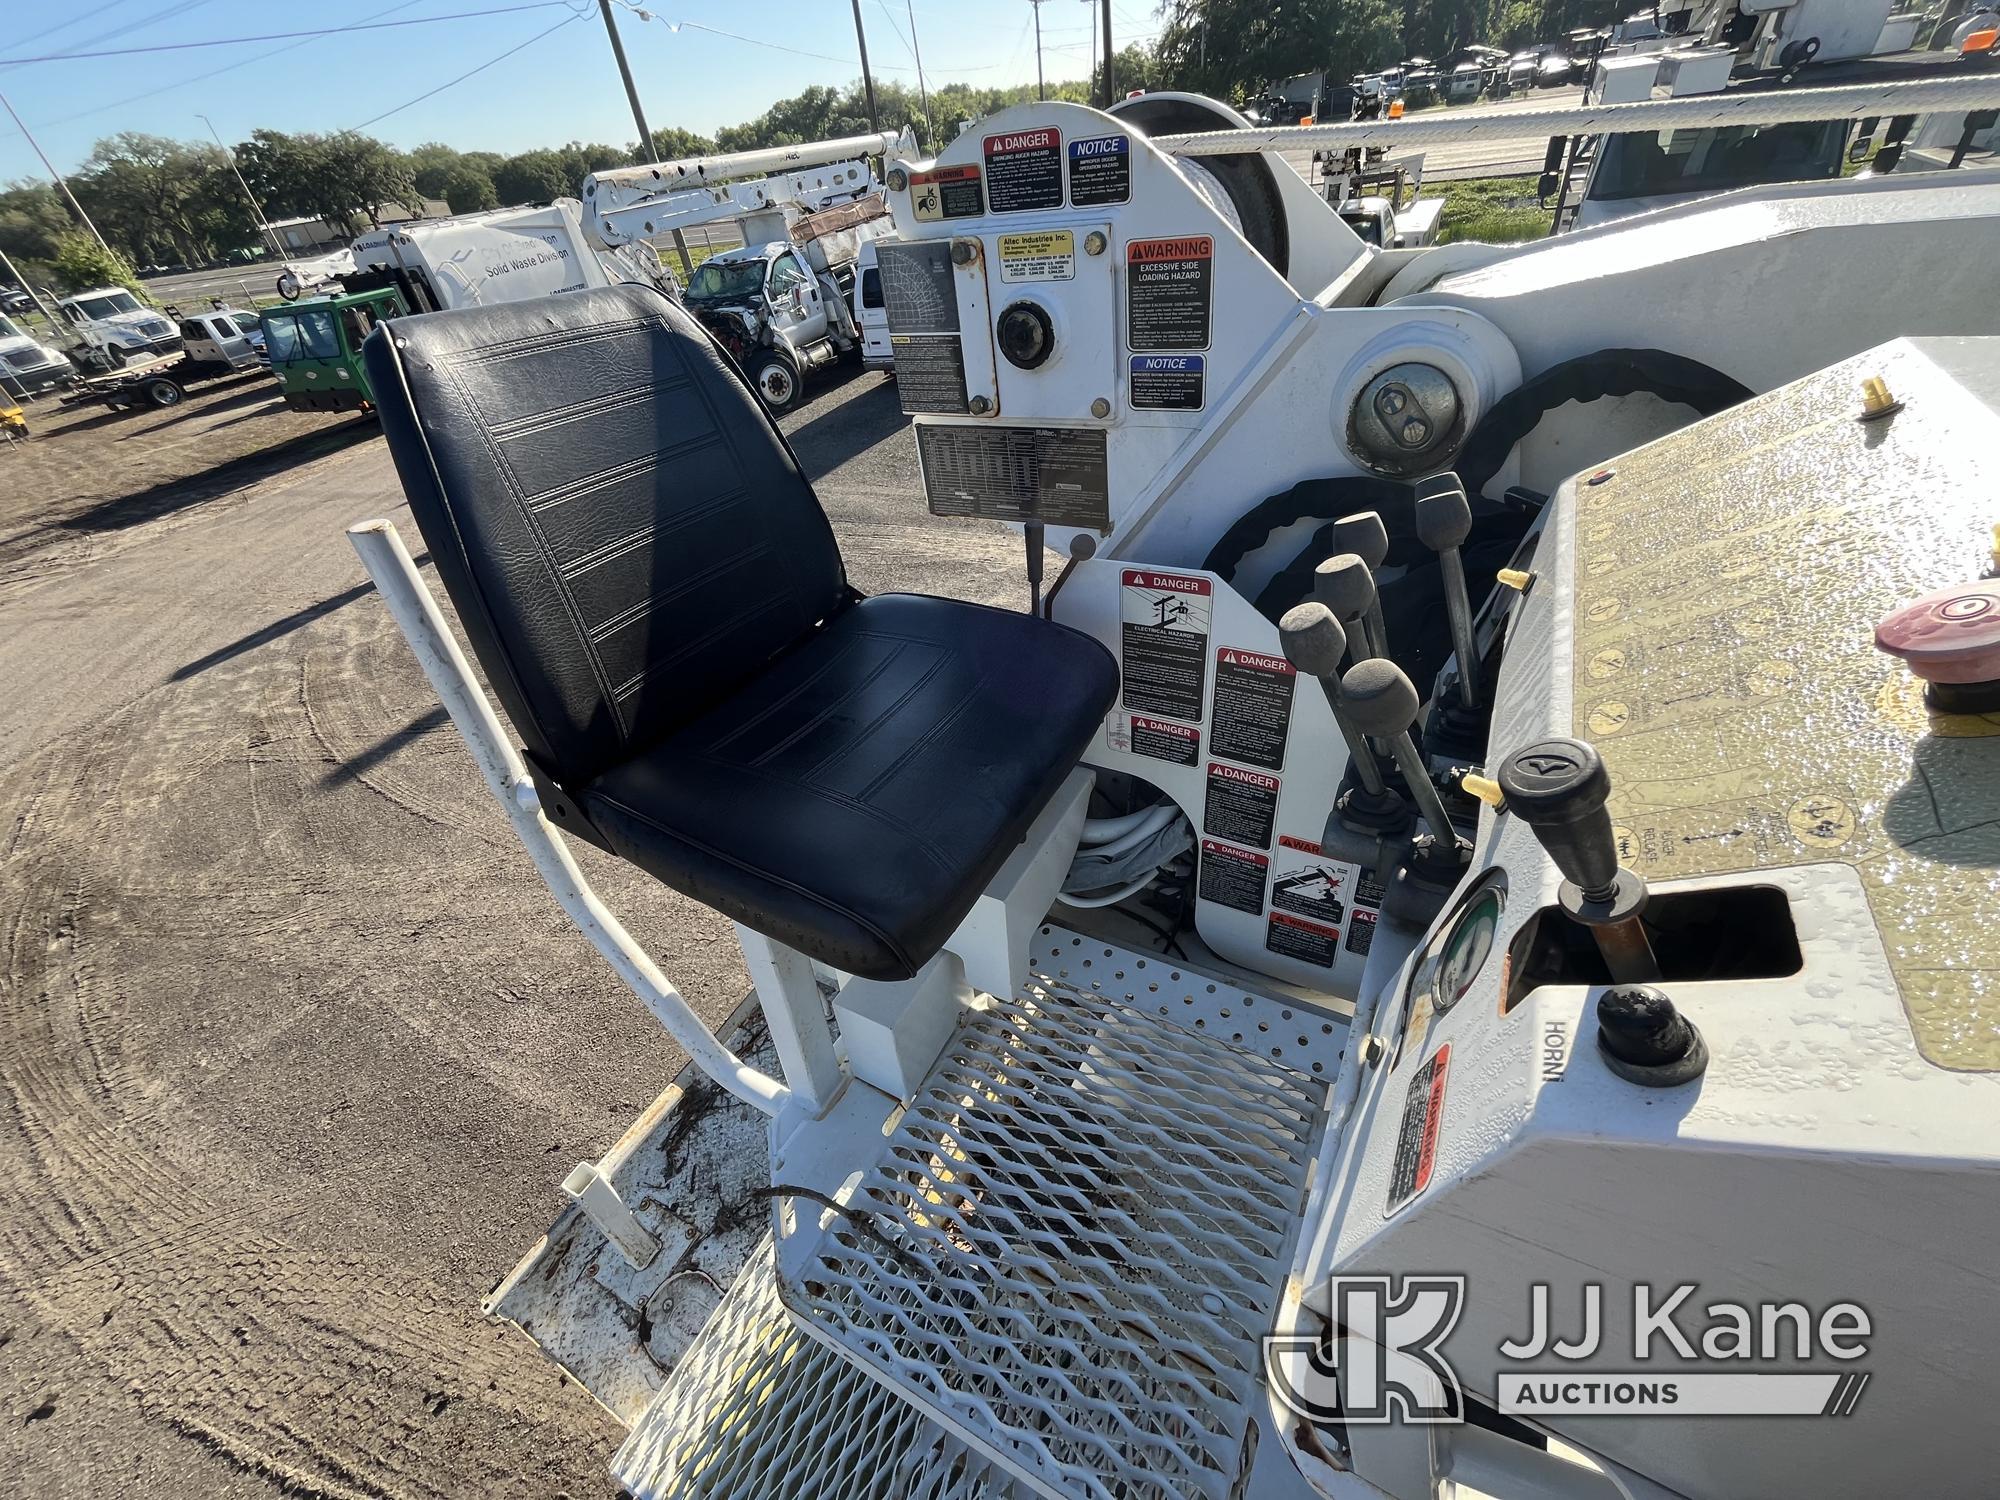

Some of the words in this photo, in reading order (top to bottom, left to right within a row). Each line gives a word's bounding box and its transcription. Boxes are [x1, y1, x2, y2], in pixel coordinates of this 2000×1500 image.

[1005, 133, 1049, 150] DANGER
[1077, 138, 1119, 155] NOTICE
[1004, 237, 1020, 245] Altec
[1022, 235, 1053, 243] Industries
[1144, 241, 1209, 258] WARNING
[485, 263, 510, 278] Solid
[510, 257, 537, 271] Waste
[537, 249, 569, 264] Division
[1140, 262, 1180, 272] EXCESSIVE
[1181, 261, 1199, 270] SIDE
[1138, 272, 1170, 282] LOADING
[1171, 271, 1201, 280] HAZARD
[1145, 358, 1188, 369] NOTICE
[1153, 577, 1199, 591] DANGER
[1134, 626, 1167, 635] ELECTRICAL
[1168, 629, 1195, 640] HAZARDS
[1240, 655, 1287, 671] DANGER
[1150, 721, 1191, 737] DANGER
[1224, 767, 1274, 788] DANGER
[1643, 827, 1658, 864] RELEASE
[1662, 830, 1675, 857] AUGER
[1221, 846, 1256, 861] DANGER
[1287, 918, 1333, 936] WARNING
[1422, 1084, 1441, 1169] WARNING
